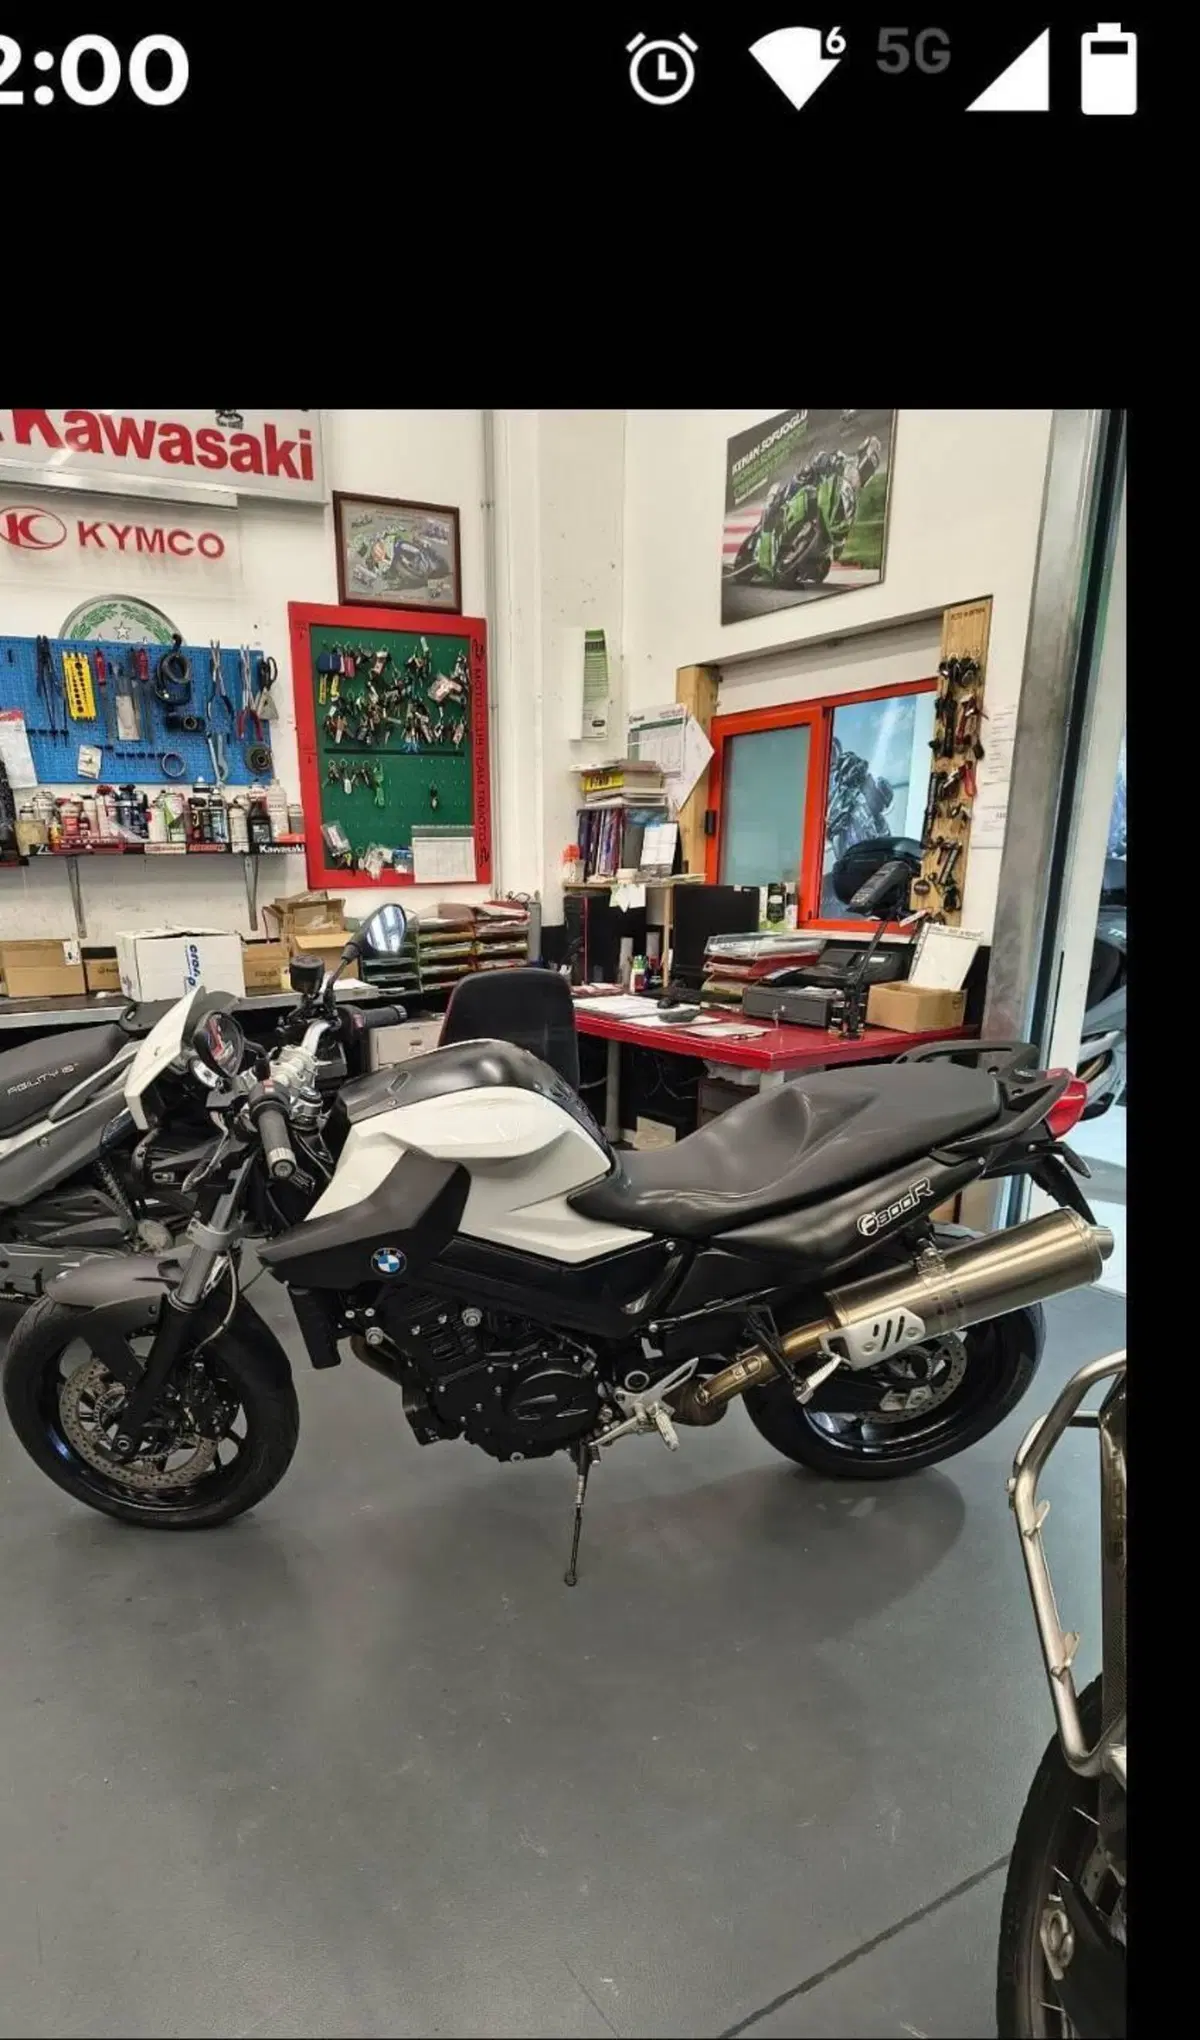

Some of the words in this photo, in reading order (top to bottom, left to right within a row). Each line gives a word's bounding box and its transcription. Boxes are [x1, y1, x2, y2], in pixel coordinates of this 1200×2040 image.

[12, 409, 315, 481] Kawasaki
[76, 520, 226, 560] KYMCO
[474, 668, 483, 709] MOTO
[259, 844, 305, 854] Kawasaki
[857, 1176, 935, 1236] F800R
